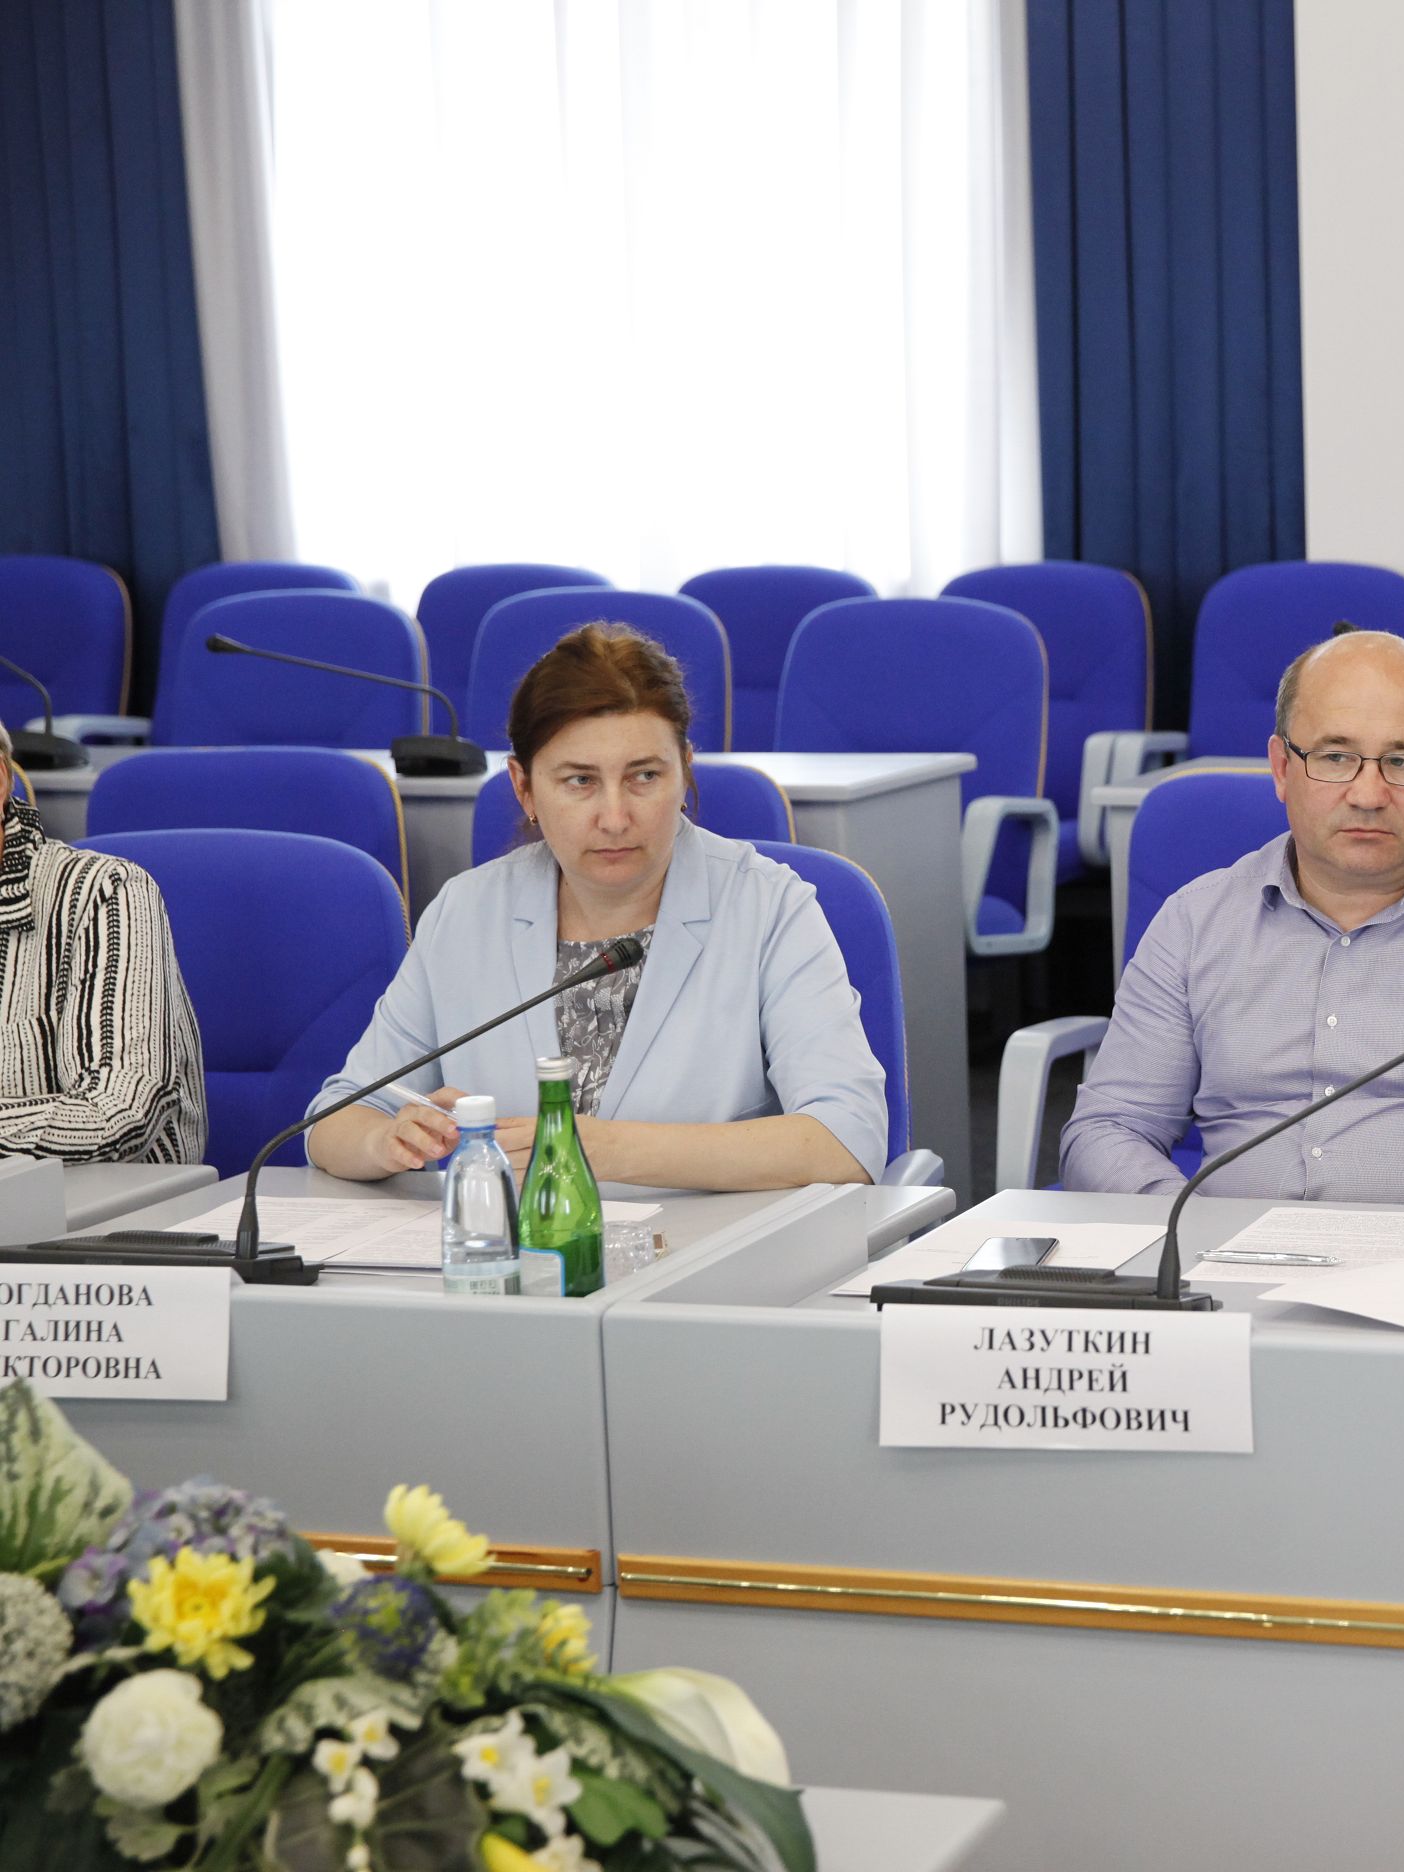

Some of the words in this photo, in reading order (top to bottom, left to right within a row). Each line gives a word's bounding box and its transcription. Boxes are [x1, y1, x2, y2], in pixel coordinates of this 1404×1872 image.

[2, 1319, 124, 1343] ГАЛИНА
[973, 1327, 1151, 1355] ЛАЗУТКИН
[997, 1362, 1129, 1394] АНДРЕЙ
[939, 1402, 1190, 1433] РУДОЛЬФОВИЧ
